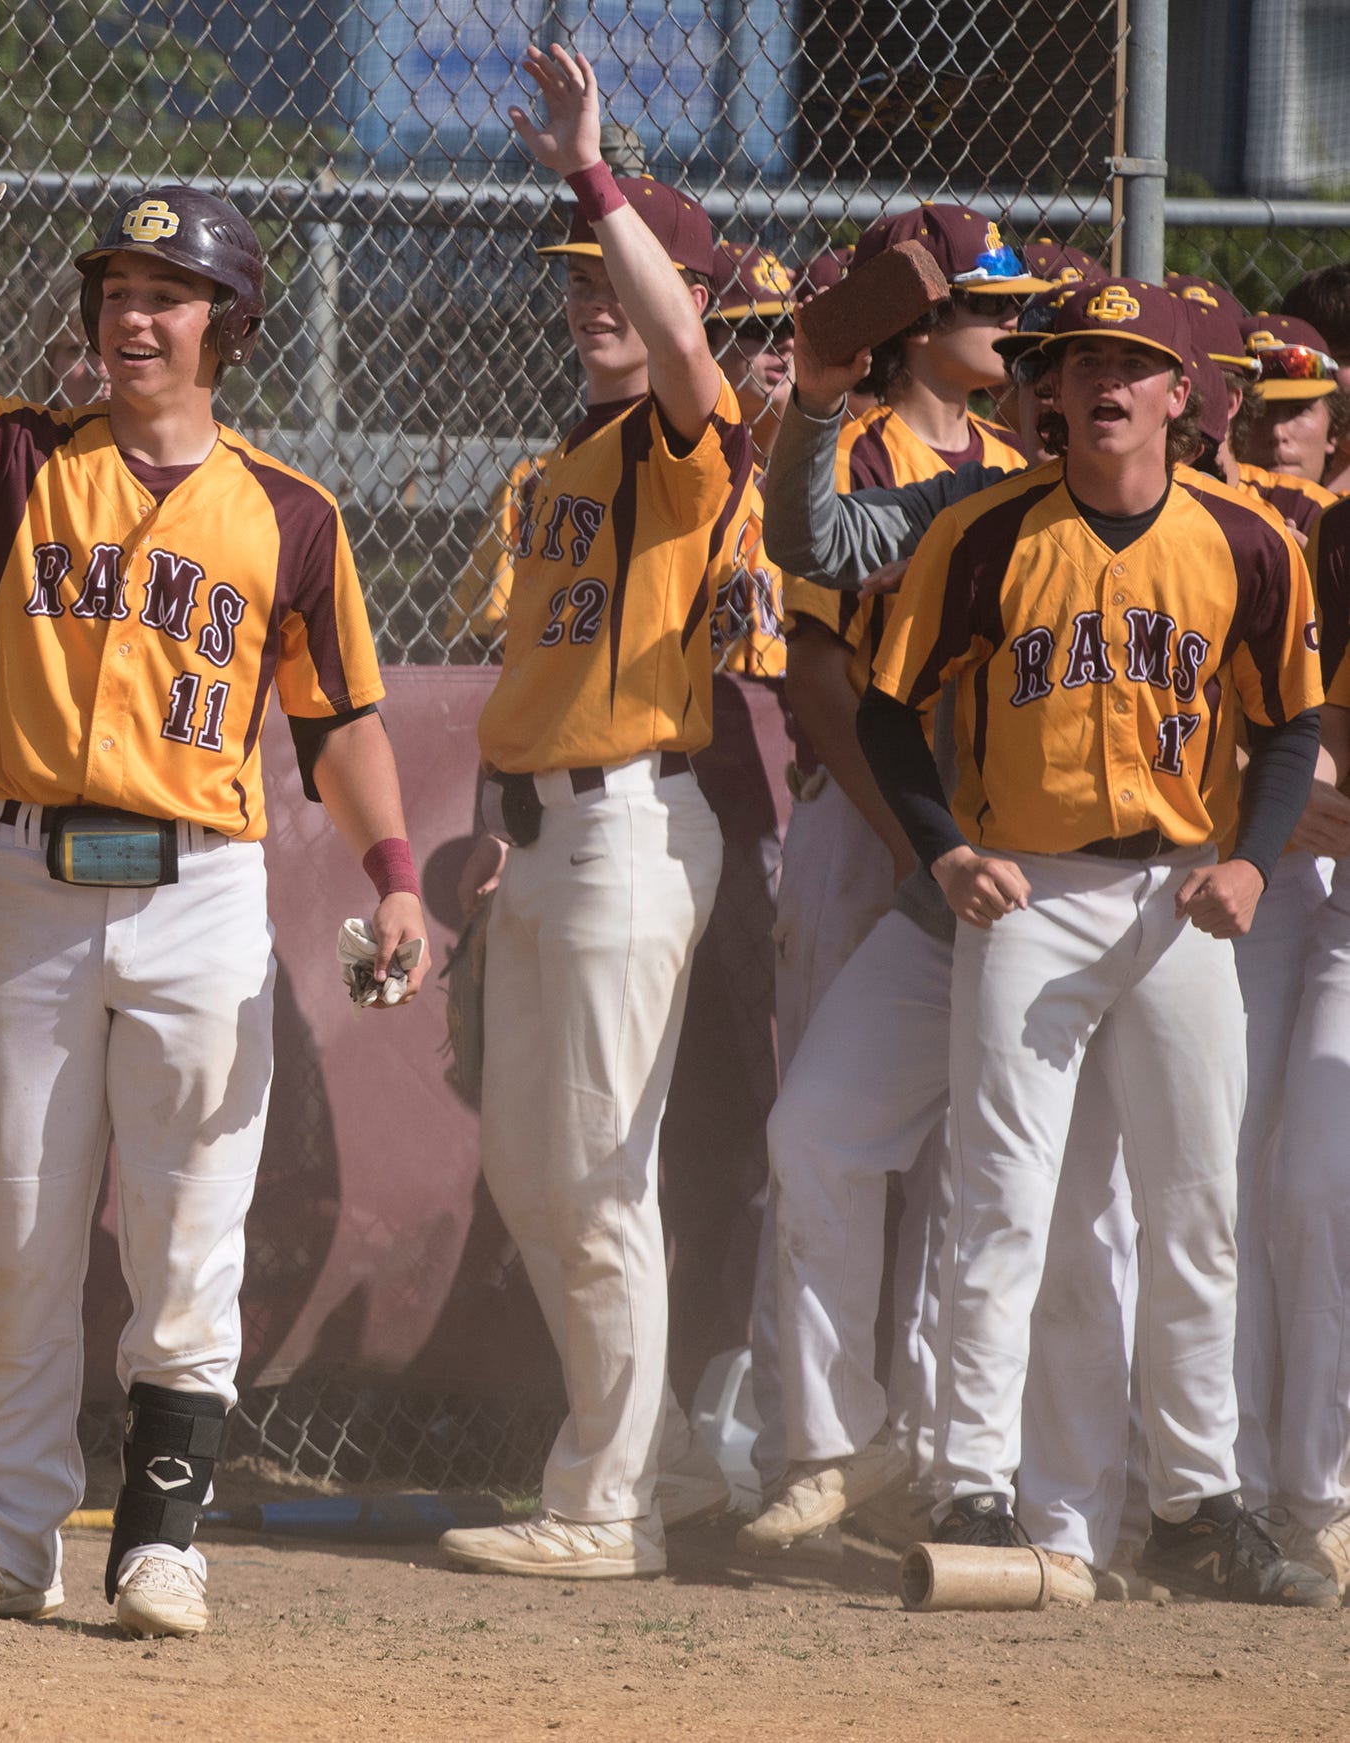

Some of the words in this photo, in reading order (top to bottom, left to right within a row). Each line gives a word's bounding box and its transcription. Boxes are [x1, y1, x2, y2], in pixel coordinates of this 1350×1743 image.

[23, 542, 247, 668] RAMS
[1011, 608, 1209, 707] RAMS
[161, 671, 231, 753] 11
